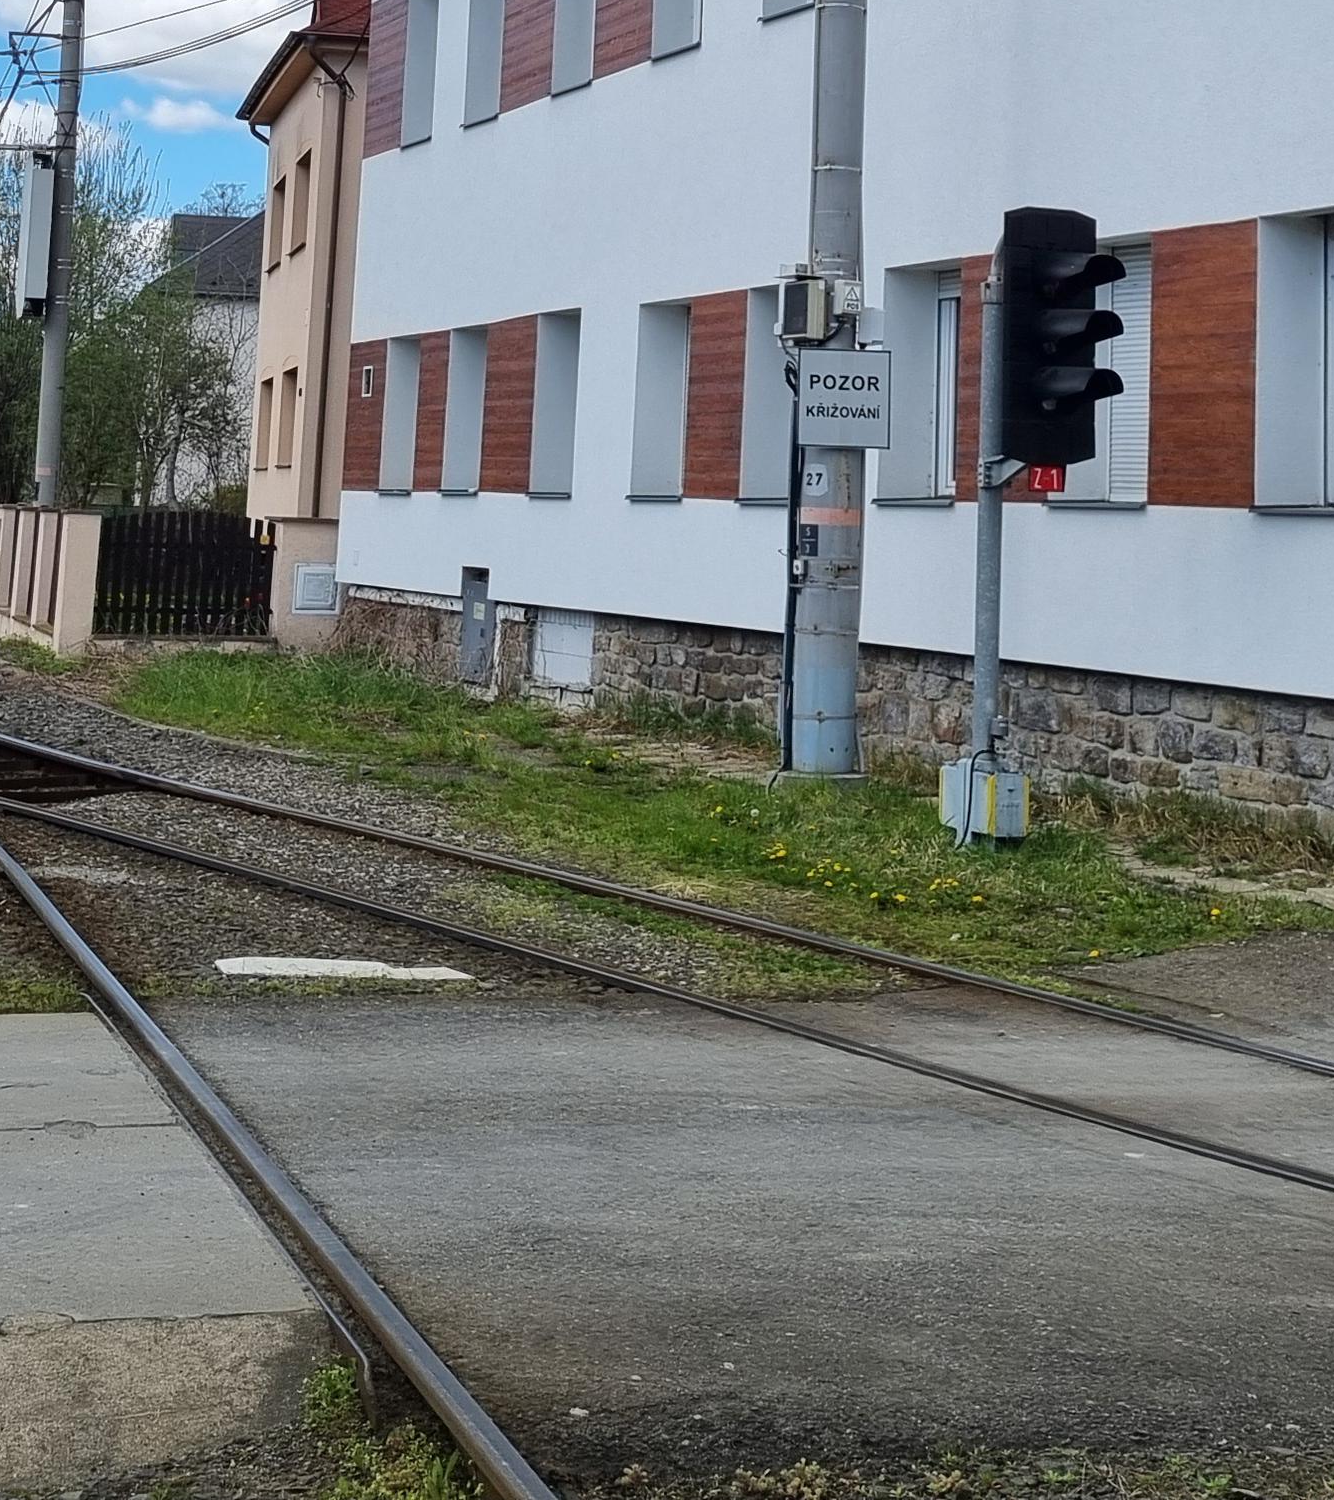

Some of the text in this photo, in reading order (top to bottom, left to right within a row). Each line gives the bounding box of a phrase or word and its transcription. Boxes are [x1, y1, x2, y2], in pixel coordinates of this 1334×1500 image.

[809, 374, 880, 391] POZOR
[806, 402, 881, 419] KŘIŽOVÁNÍ
[805, 473, 823, 486] 27
[1033, 467, 1058, 490] Z-1
